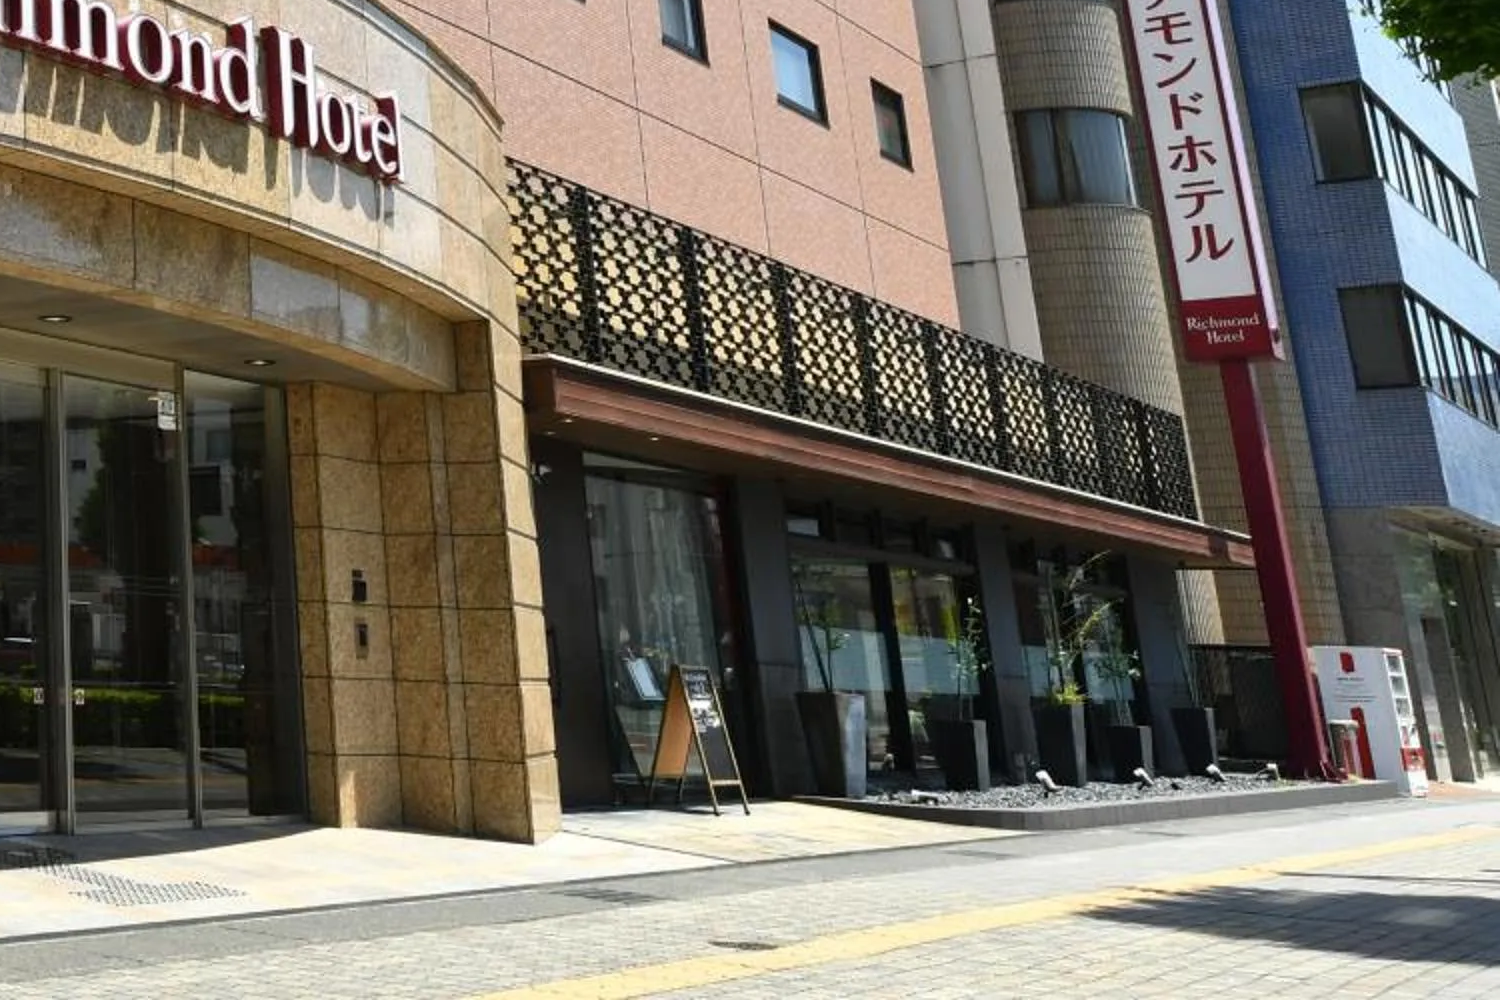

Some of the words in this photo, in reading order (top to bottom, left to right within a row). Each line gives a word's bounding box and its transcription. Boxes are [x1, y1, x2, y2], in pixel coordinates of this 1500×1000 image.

[266, 25, 406, 182] Hotel
[1187, 312, 1260, 330] Richmond
[1207, 329, 1245, 344] Hotel
